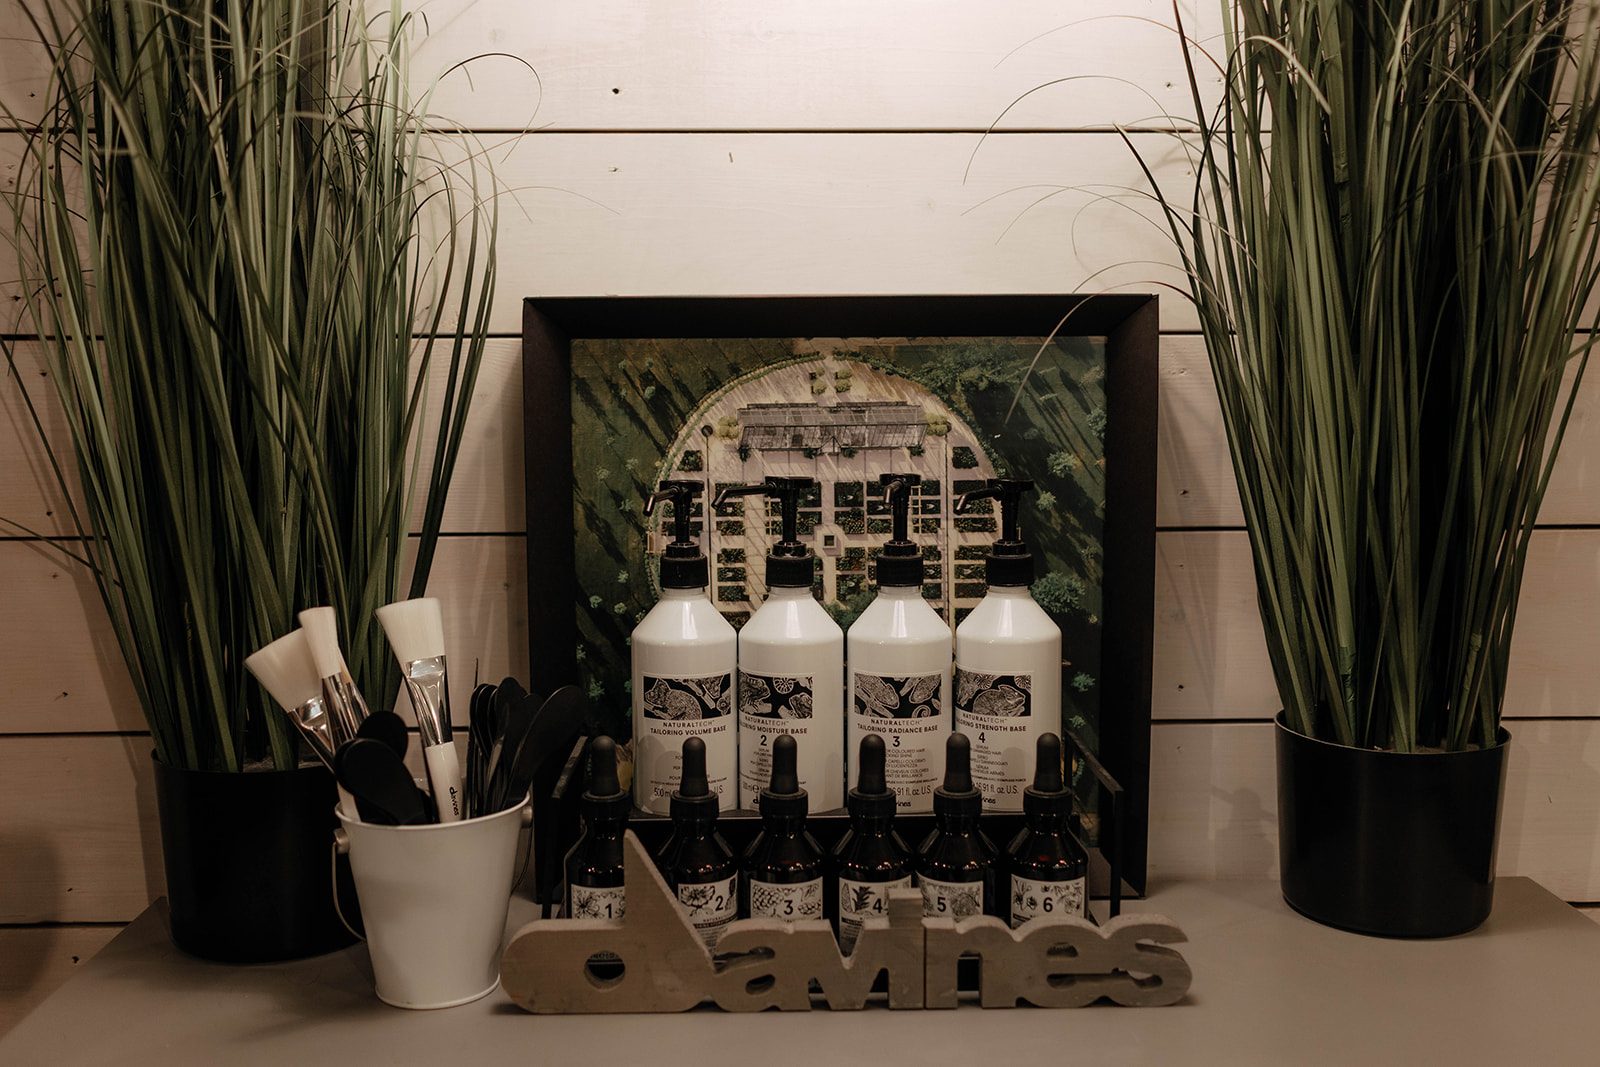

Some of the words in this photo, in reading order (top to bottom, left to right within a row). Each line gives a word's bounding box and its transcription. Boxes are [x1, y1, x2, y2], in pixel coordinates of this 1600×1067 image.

[650, 728, 683, 736] TAILORING
[685, 728, 711, 736] VOLUME
[713, 725, 727, 733] BASE
[757, 726, 788, 735] MOISTURE
[857, 723, 887, 733] TAILORING
[888, 726, 922, 734] RADIANCE
[975, 723, 1008, 732] STRENGTH
[760, 734, 767, 746] 2
[892, 735, 900, 747] 3
[978, 731, 986, 743] 4
[604, 902, 613, 919] 1
[715, 895, 724, 912] 2
[783, 899, 794, 915] 3
[872, 897, 883, 914] 4
[937, 896, 947, 912] 5
[1042, 897, 1053, 913] 6
[500, 829, 1193, 1015] davines
